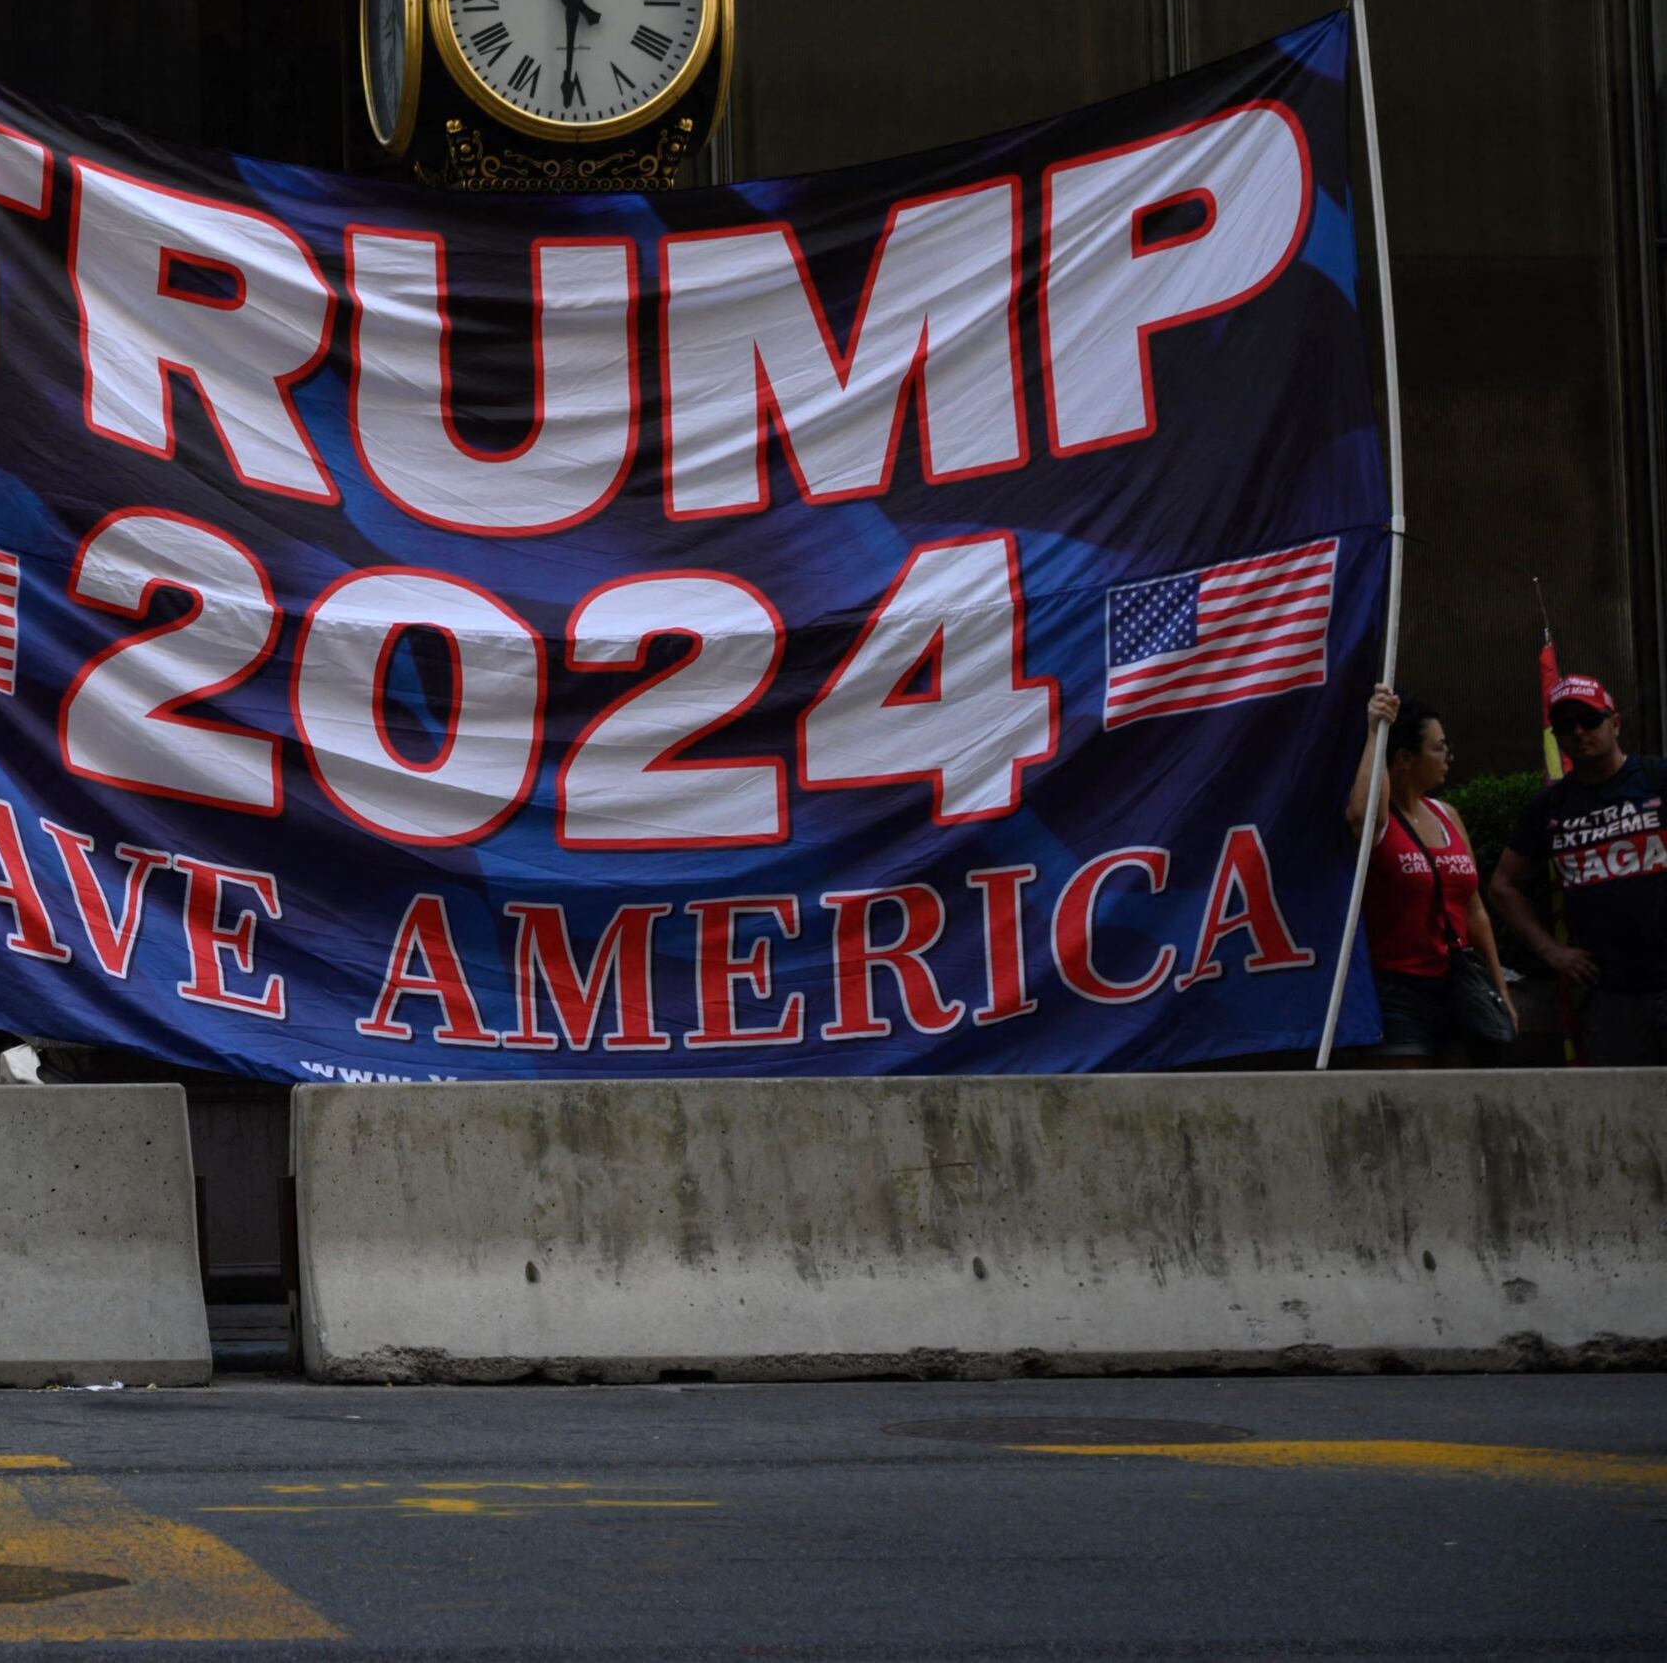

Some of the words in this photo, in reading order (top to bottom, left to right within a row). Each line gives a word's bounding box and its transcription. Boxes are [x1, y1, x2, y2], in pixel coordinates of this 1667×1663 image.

[59, 506, 1059, 849] 2024
[1552, 810, 1661, 850] EXTREME
[1562, 800, 1637, 829] ULTRA
[1401, 862, 1433, 874] GRE
[1448, 863, 1478, 876] AGA
[1553, 834, 1667, 888] MAGA
[356, 824, 1316, 1050] AMERICA
